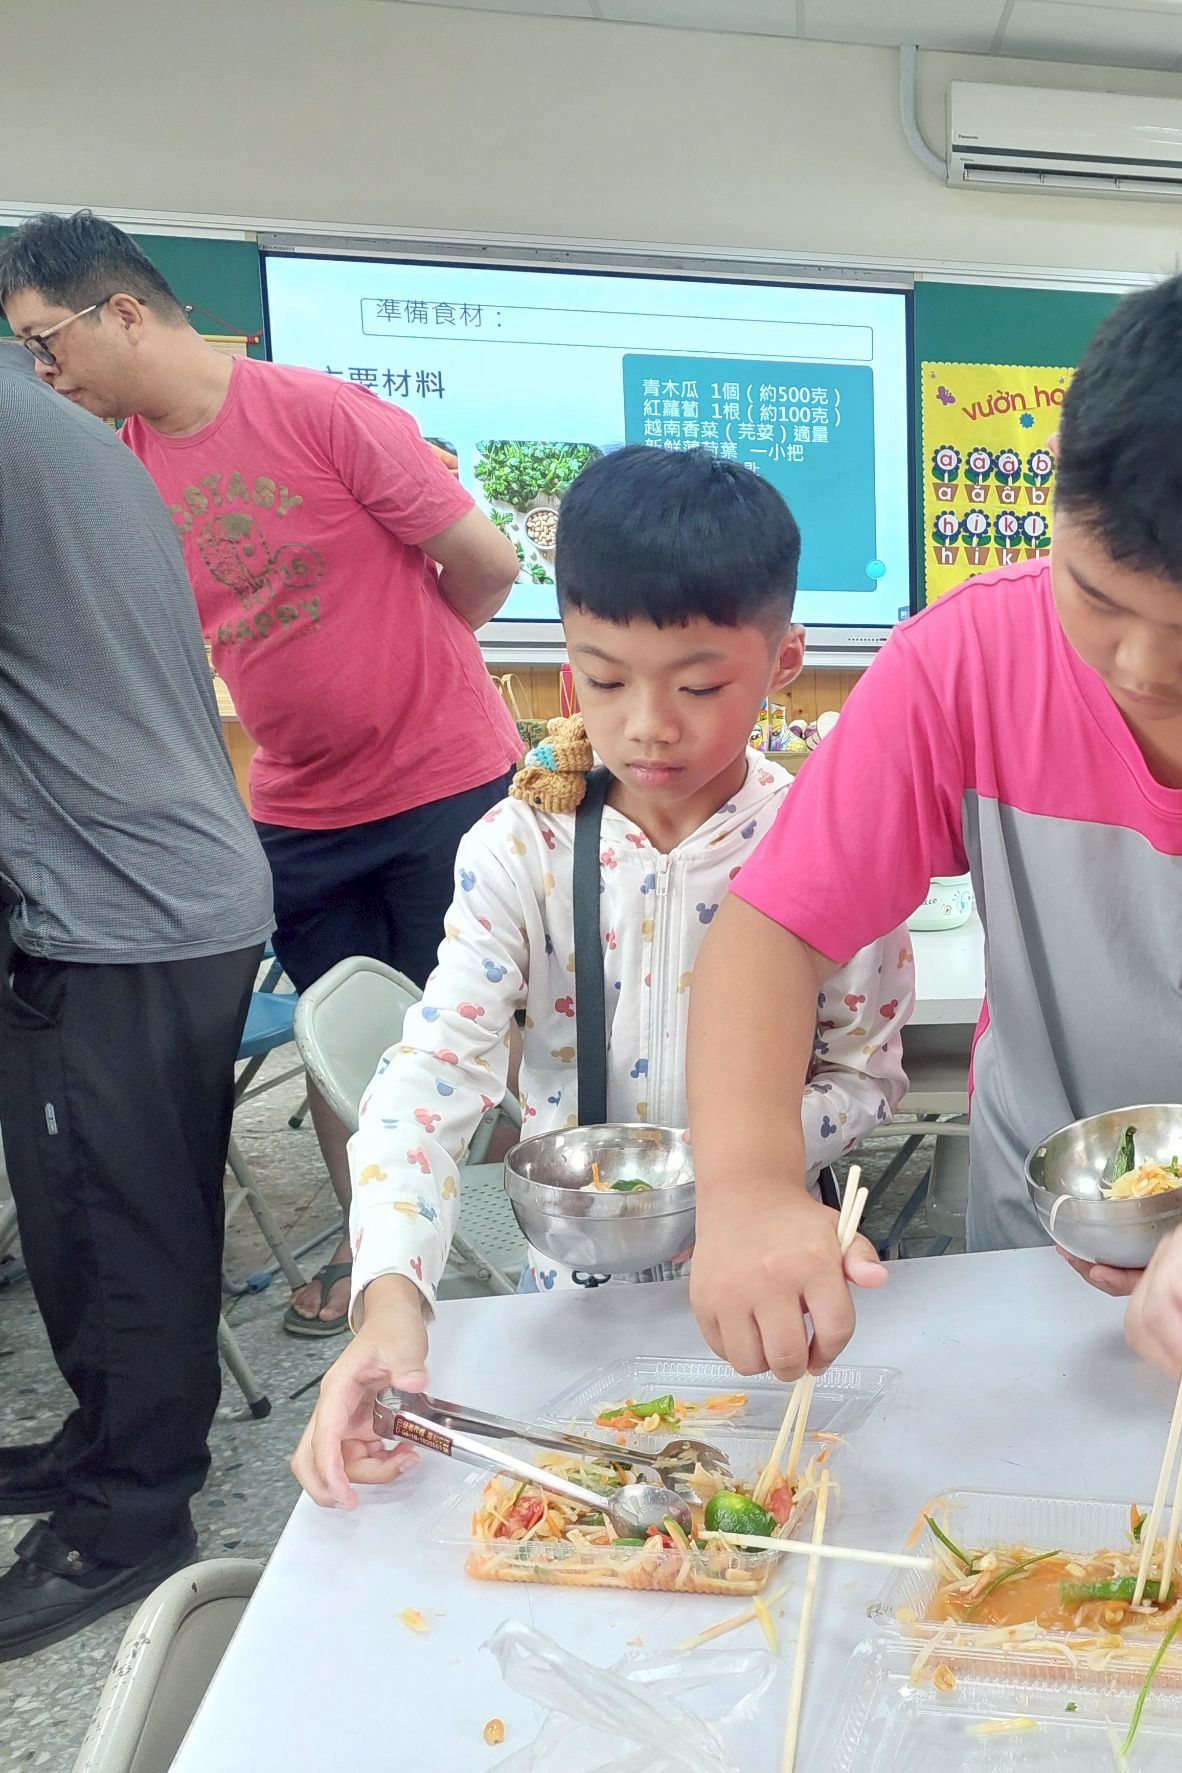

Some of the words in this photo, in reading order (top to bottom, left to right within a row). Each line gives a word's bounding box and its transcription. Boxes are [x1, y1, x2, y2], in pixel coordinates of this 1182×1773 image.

[642, 379, 699, 399] 青木瓜
[643, 399, 699, 418] 紅蘿蔔
[961, 389, 1027, 421] vườn
[1033, 385, 1065, 408] ho
[749, 443, 804, 463] 一小把
[940, 454, 953, 467] a
[1036, 455, 1049, 472] b
[938, 487, 952, 501] a
[1032, 487, 1045, 504] b
[943, 517, 954, 534] h
[1004, 516, 1014, 533] k
[941, 547, 953, 564] h
